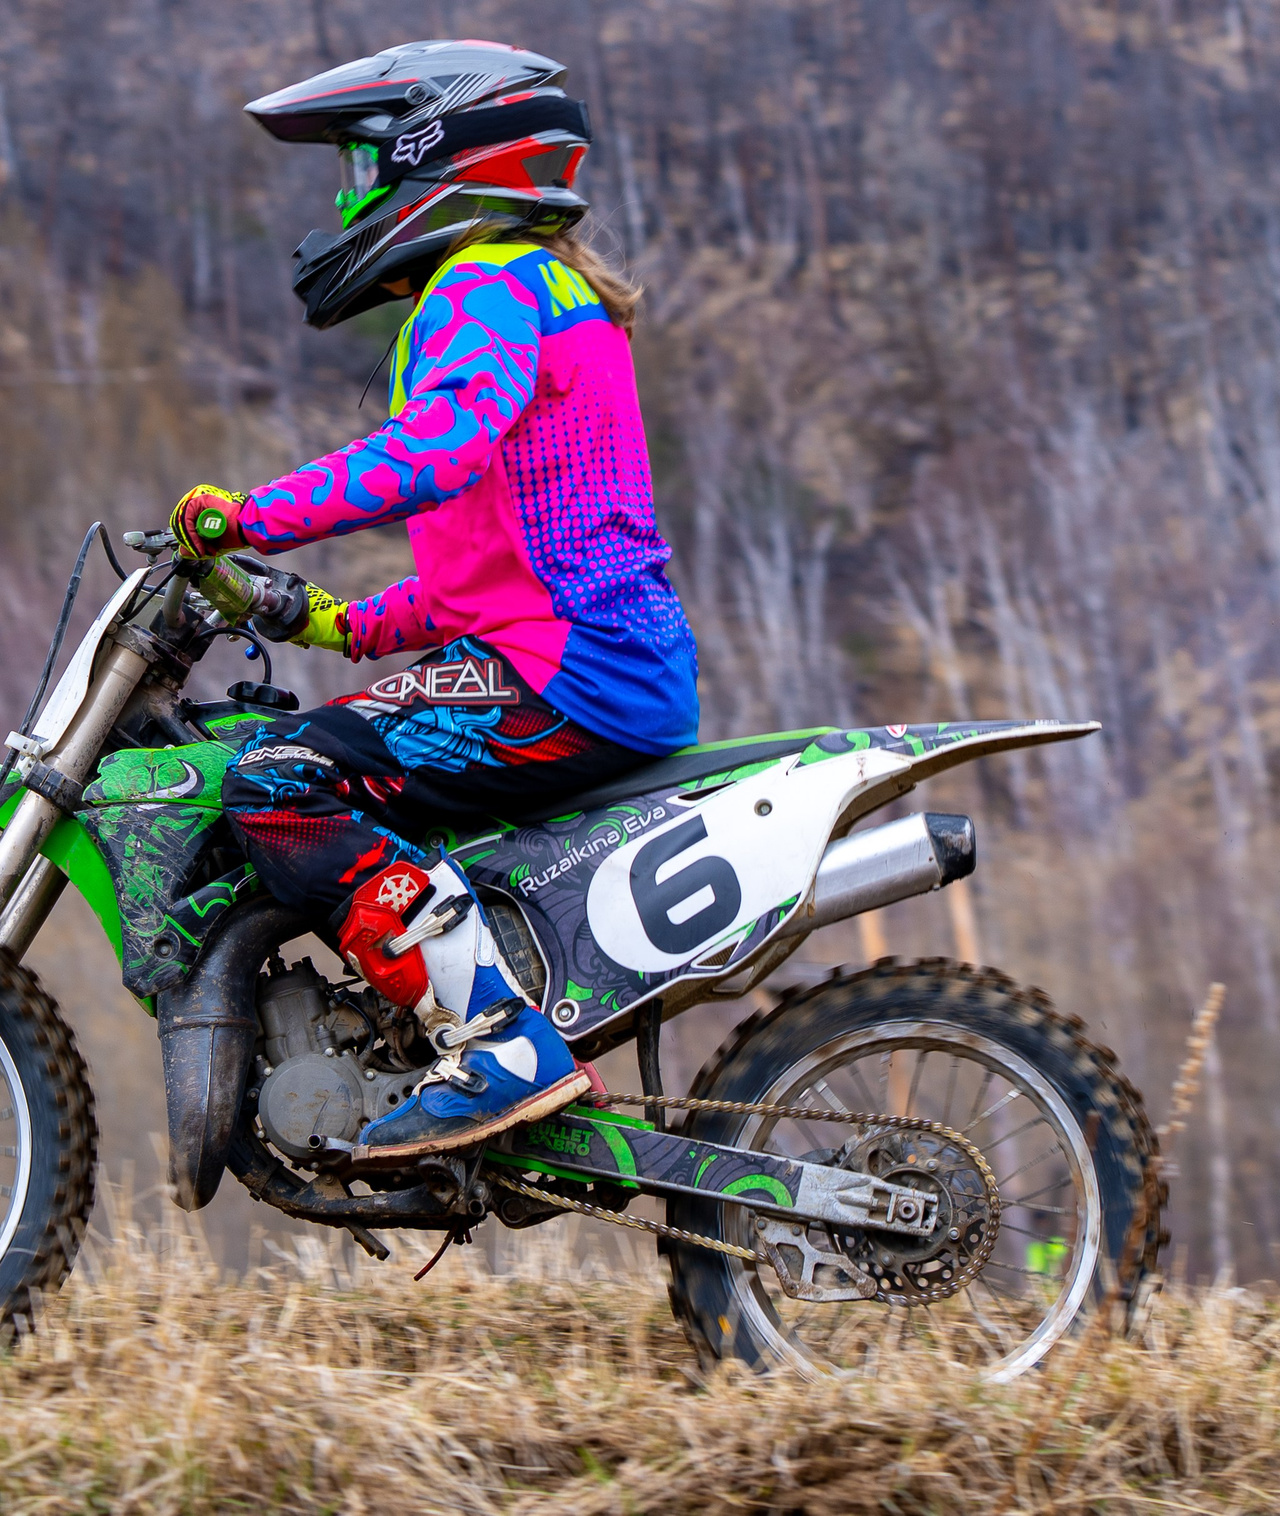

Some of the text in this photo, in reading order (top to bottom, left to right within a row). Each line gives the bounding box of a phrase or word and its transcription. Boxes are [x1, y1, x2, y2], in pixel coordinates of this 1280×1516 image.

[369, 658, 514, 702] ONEAL
[519, 805, 666, 897] Ruzaikina Eva
[630, 813, 742, 955] 6
[553, 1138, 590, 1157] BRO
